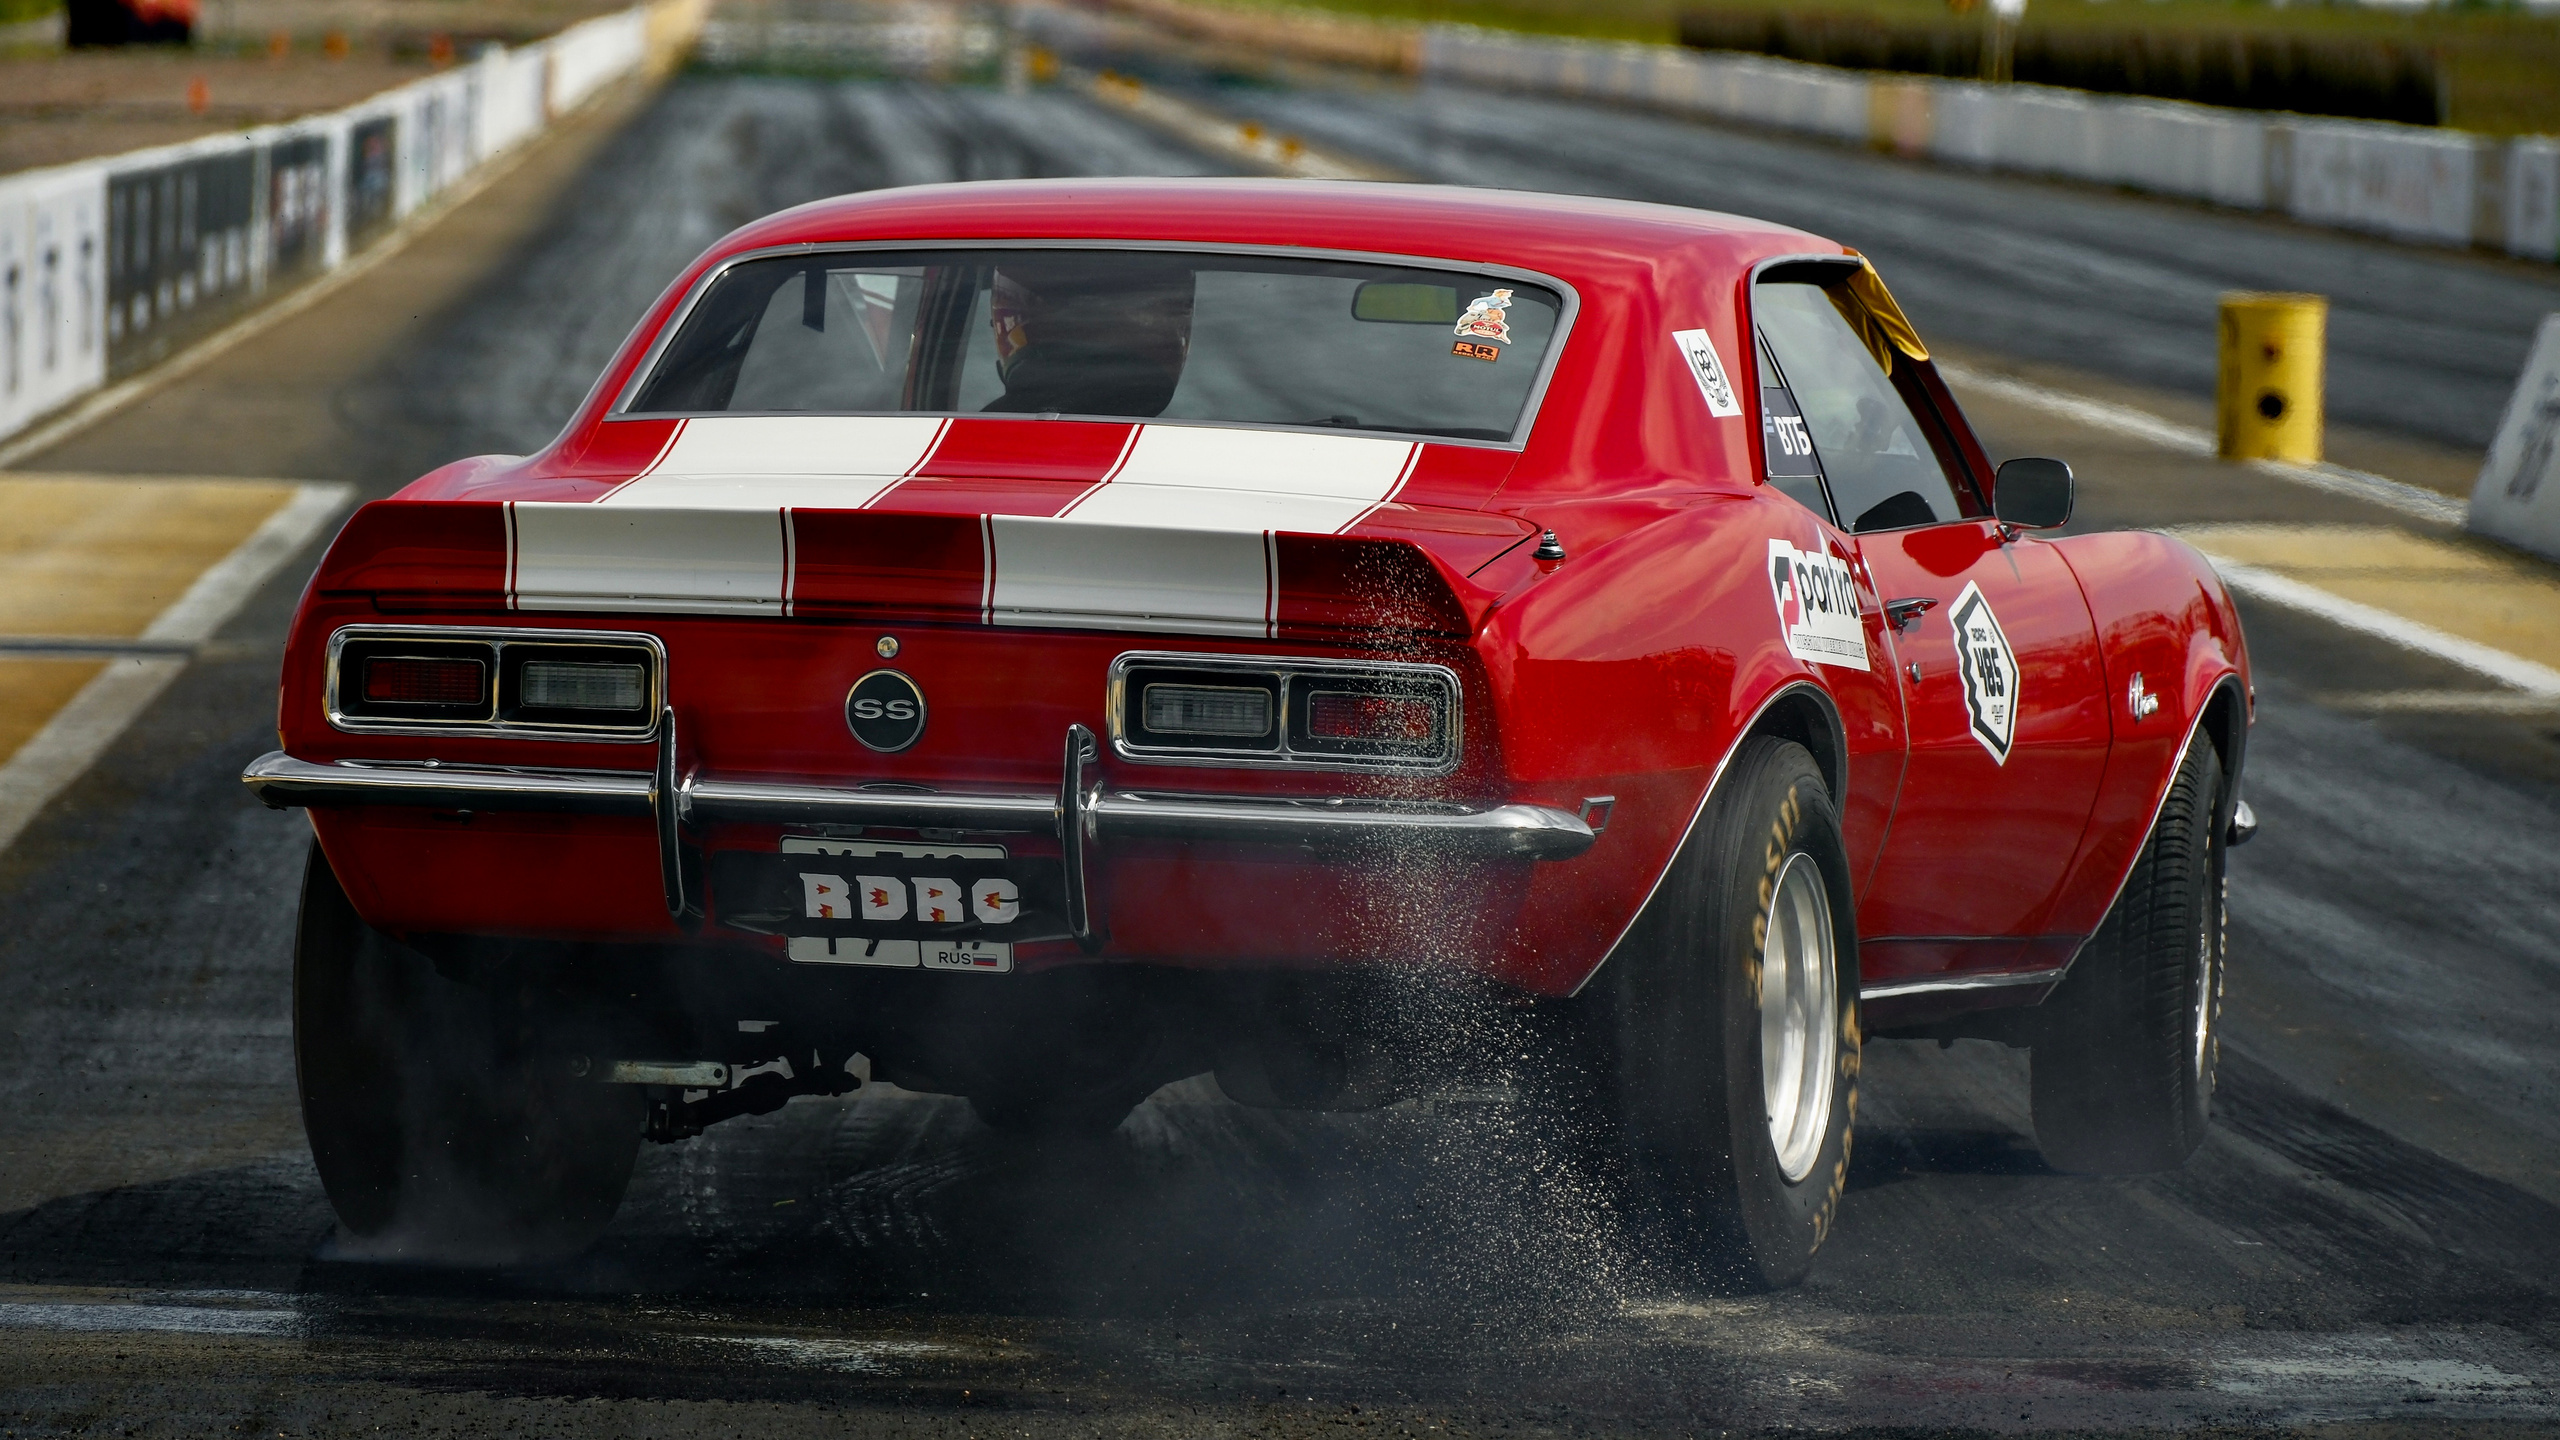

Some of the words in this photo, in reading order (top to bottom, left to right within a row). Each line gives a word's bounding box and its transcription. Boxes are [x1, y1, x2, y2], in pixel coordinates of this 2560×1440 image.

[1472, 324, 1501, 333] MOTUL
[1773, 415, 1812, 455] ВТБ
[1973, 647, 2004, 697] 485
[854, 698, 915, 720] SS
[799, 872, 1020, 924] RDRC
[938, 951, 971, 965] RUS
